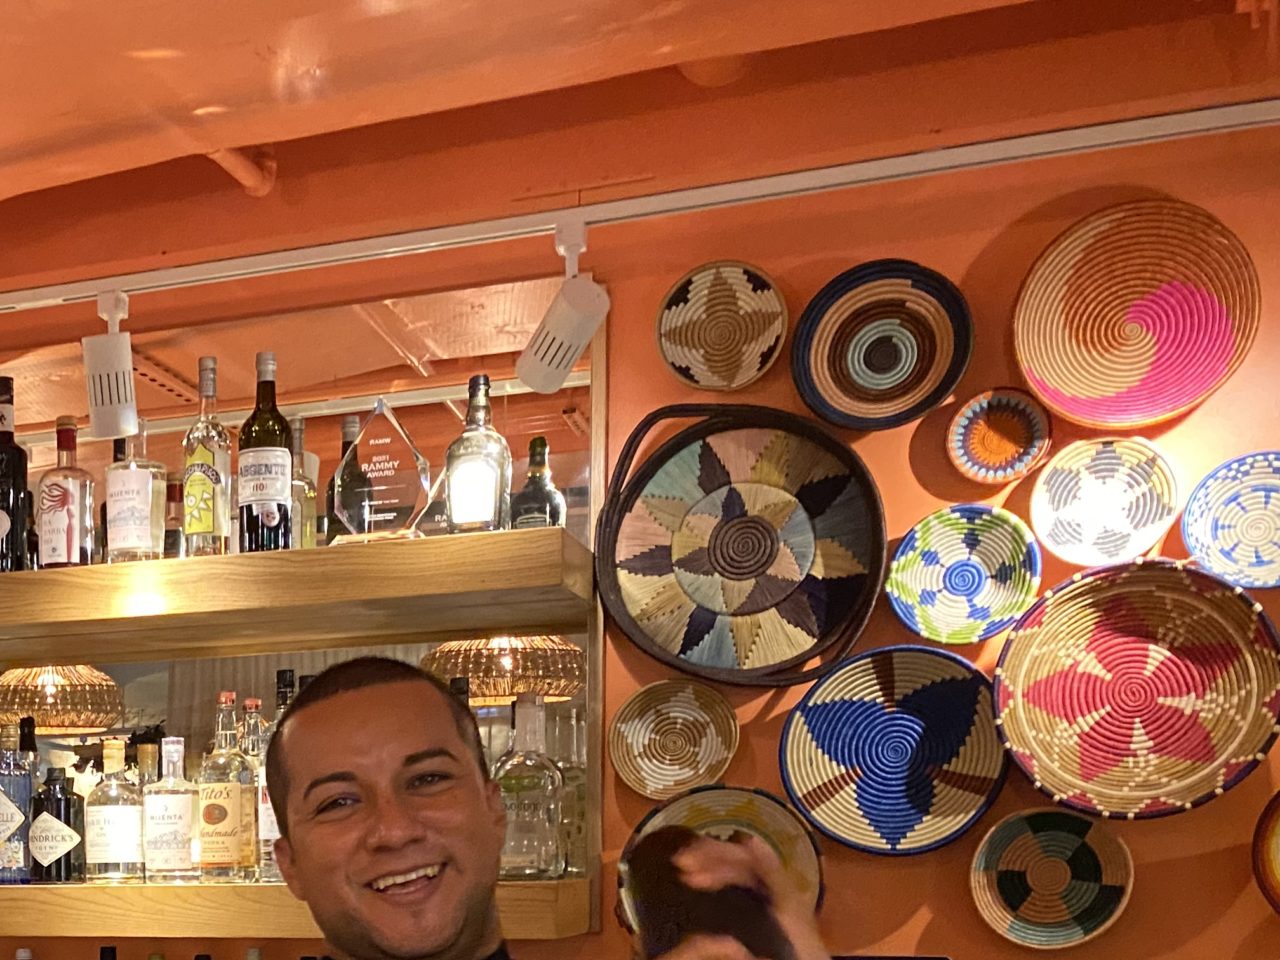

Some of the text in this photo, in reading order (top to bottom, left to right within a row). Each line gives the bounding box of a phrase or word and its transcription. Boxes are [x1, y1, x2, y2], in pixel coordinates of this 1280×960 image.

[361, 461, 400, 472] RAMMY
[366, 469, 395, 478] AWARD
[201, 787, 232, 800] Tito's
